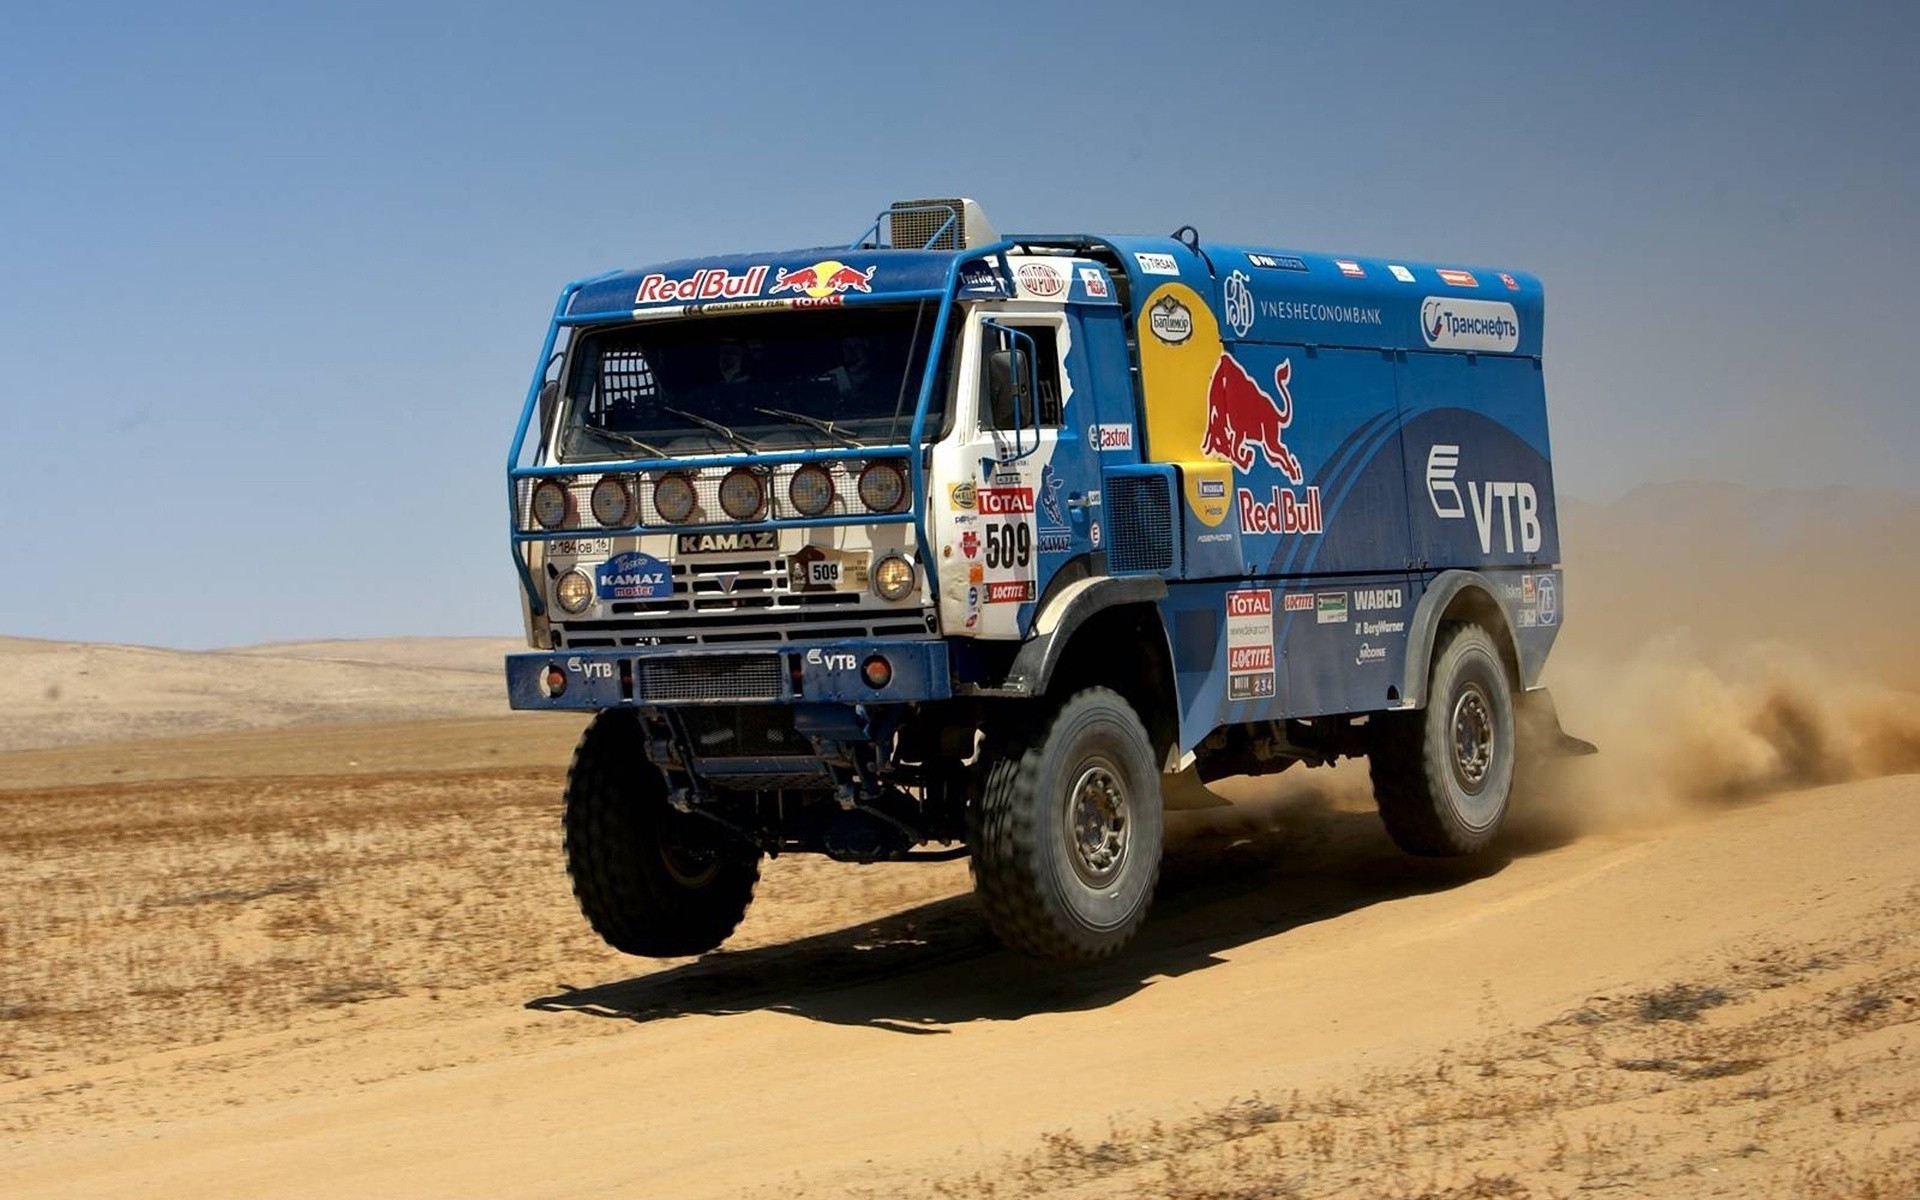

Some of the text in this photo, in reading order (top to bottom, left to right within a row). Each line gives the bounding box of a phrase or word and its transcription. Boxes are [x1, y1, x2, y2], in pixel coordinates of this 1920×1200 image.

[1148, 257, 1177, 270] TIRSAN
[794, 295, 841, 307] TOTAL
[1260, 300, 1382, 325] VNESHECONOMBANK
[1443, 311, 1517, 340] Транснефть
[1100, 428, 1130, 447] Castrol
[978, 489, 1033, 513] TOTAL
[1468, 481, 1542, 554] VTB
[680, 532, 775, 553] KAMAZ
[985, 522, 1031, 569] 509
[600, 573, 665, 586] KAMAZ
[813, 563, 839, 581] 509
[992, 586, 1025, 600] LOCTITE
[1354, 589, 1402, 611] WABCO
[1229, 594, 1270, 615] TOTAL
[1363, 620, 1404, 637] BorgWarner
[824, 652, 857, 672] VTB
[1231, 647, 1271, 669] LOCTITE
[583, 661, 613, 679] VTB
